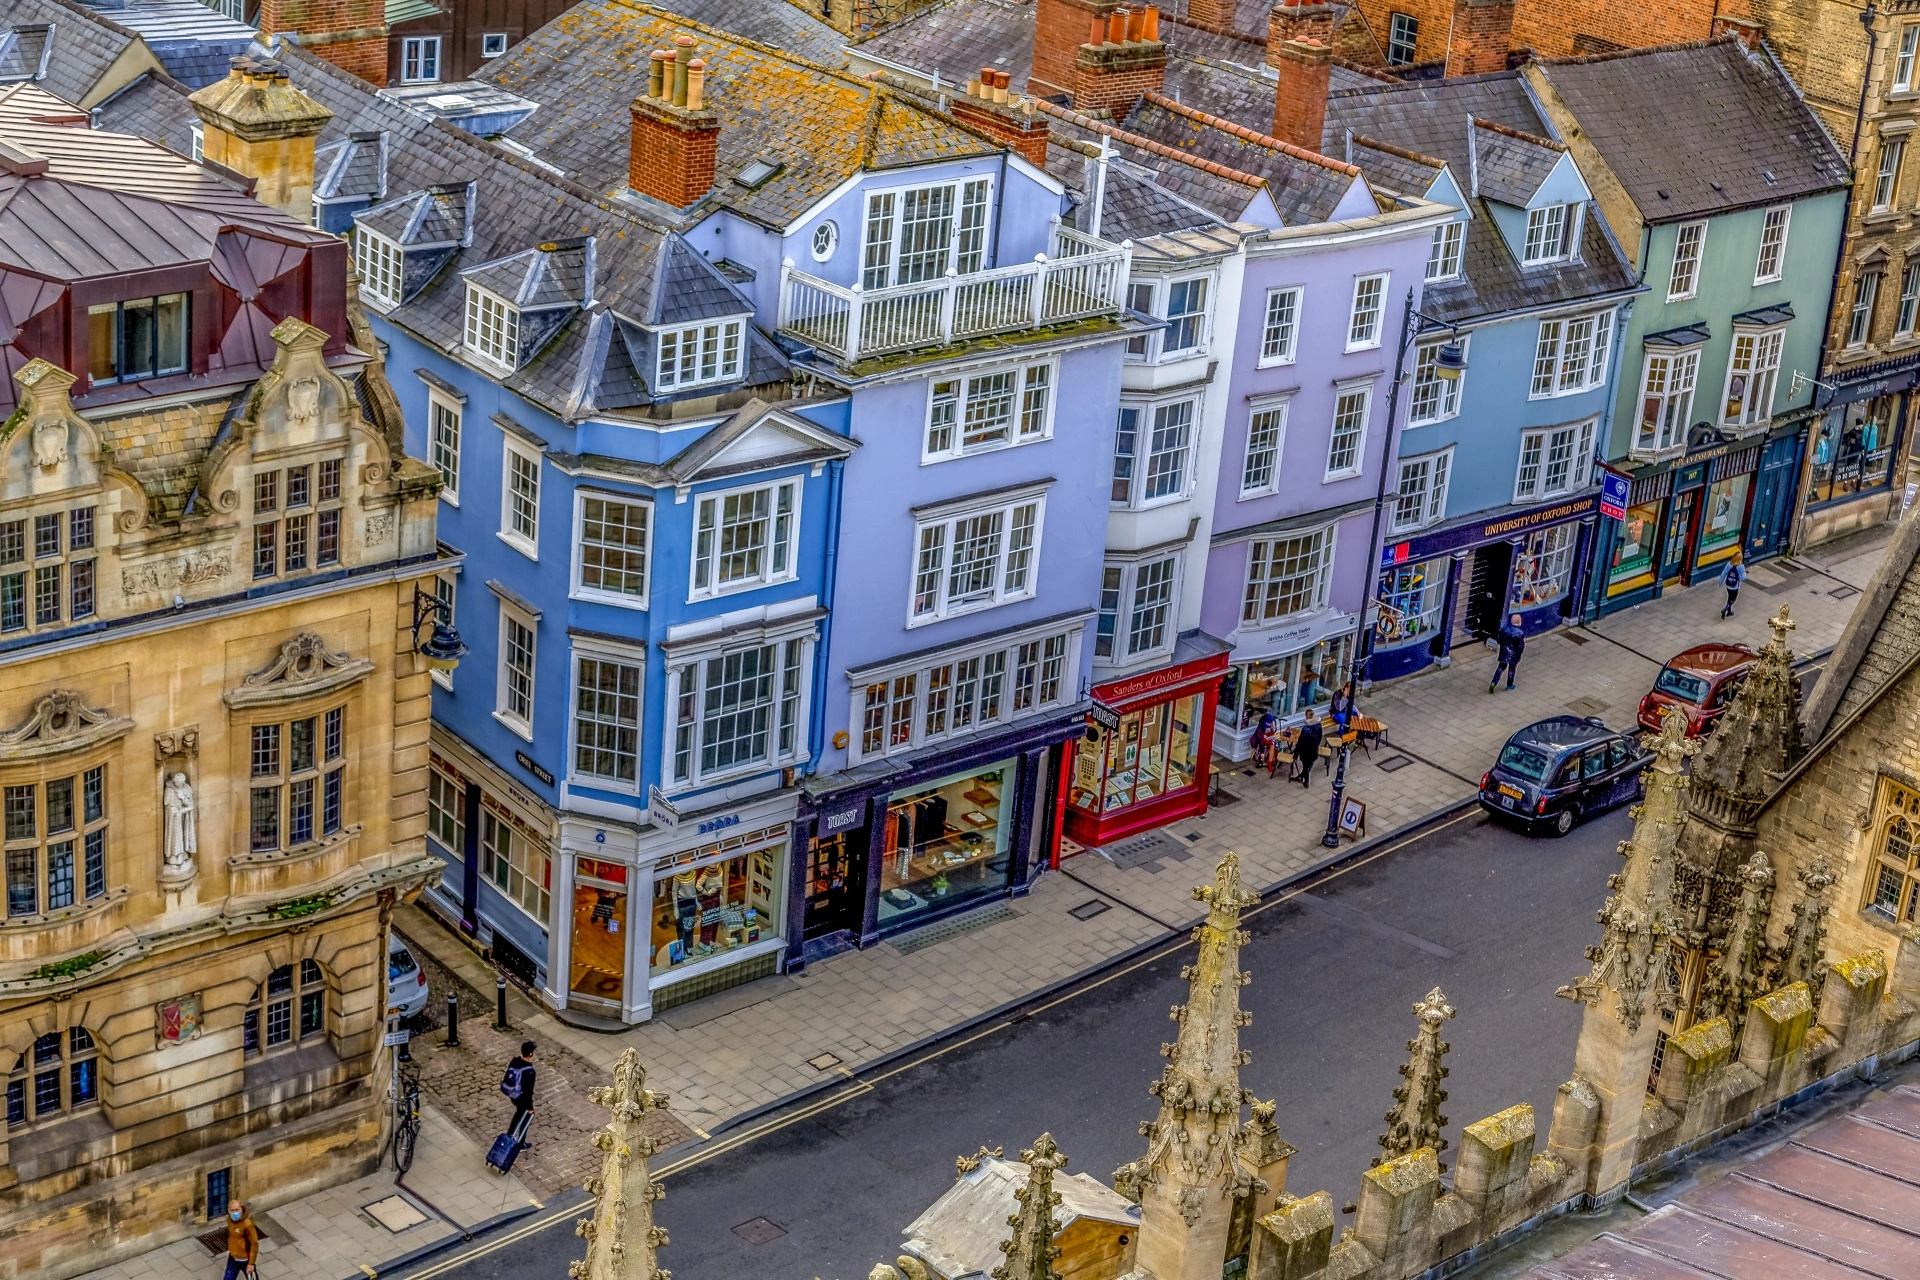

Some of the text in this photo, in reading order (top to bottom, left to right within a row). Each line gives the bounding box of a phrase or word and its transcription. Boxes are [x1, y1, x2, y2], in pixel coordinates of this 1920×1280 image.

[1857, 380, 1889, 395] Sweaty Betty
[1694, 445, 1729, 460] INSURANCE
[1603, 495, 1624, 507] OXFORD
[1484, 498, 1593, 536] UNIVERSITY OF OXFORD SHOP
[1602, 505, 1623, 517] SHOP
[1284, 630, 1298, 639] Coffee
[1112, 668, 1183, 697] Sanders of Oxford
[1092, 704, 1119, 729] TOAST
[518, 754, 552, 783] ORIEL STREET
[827, 809, 858, 829] TOAST
